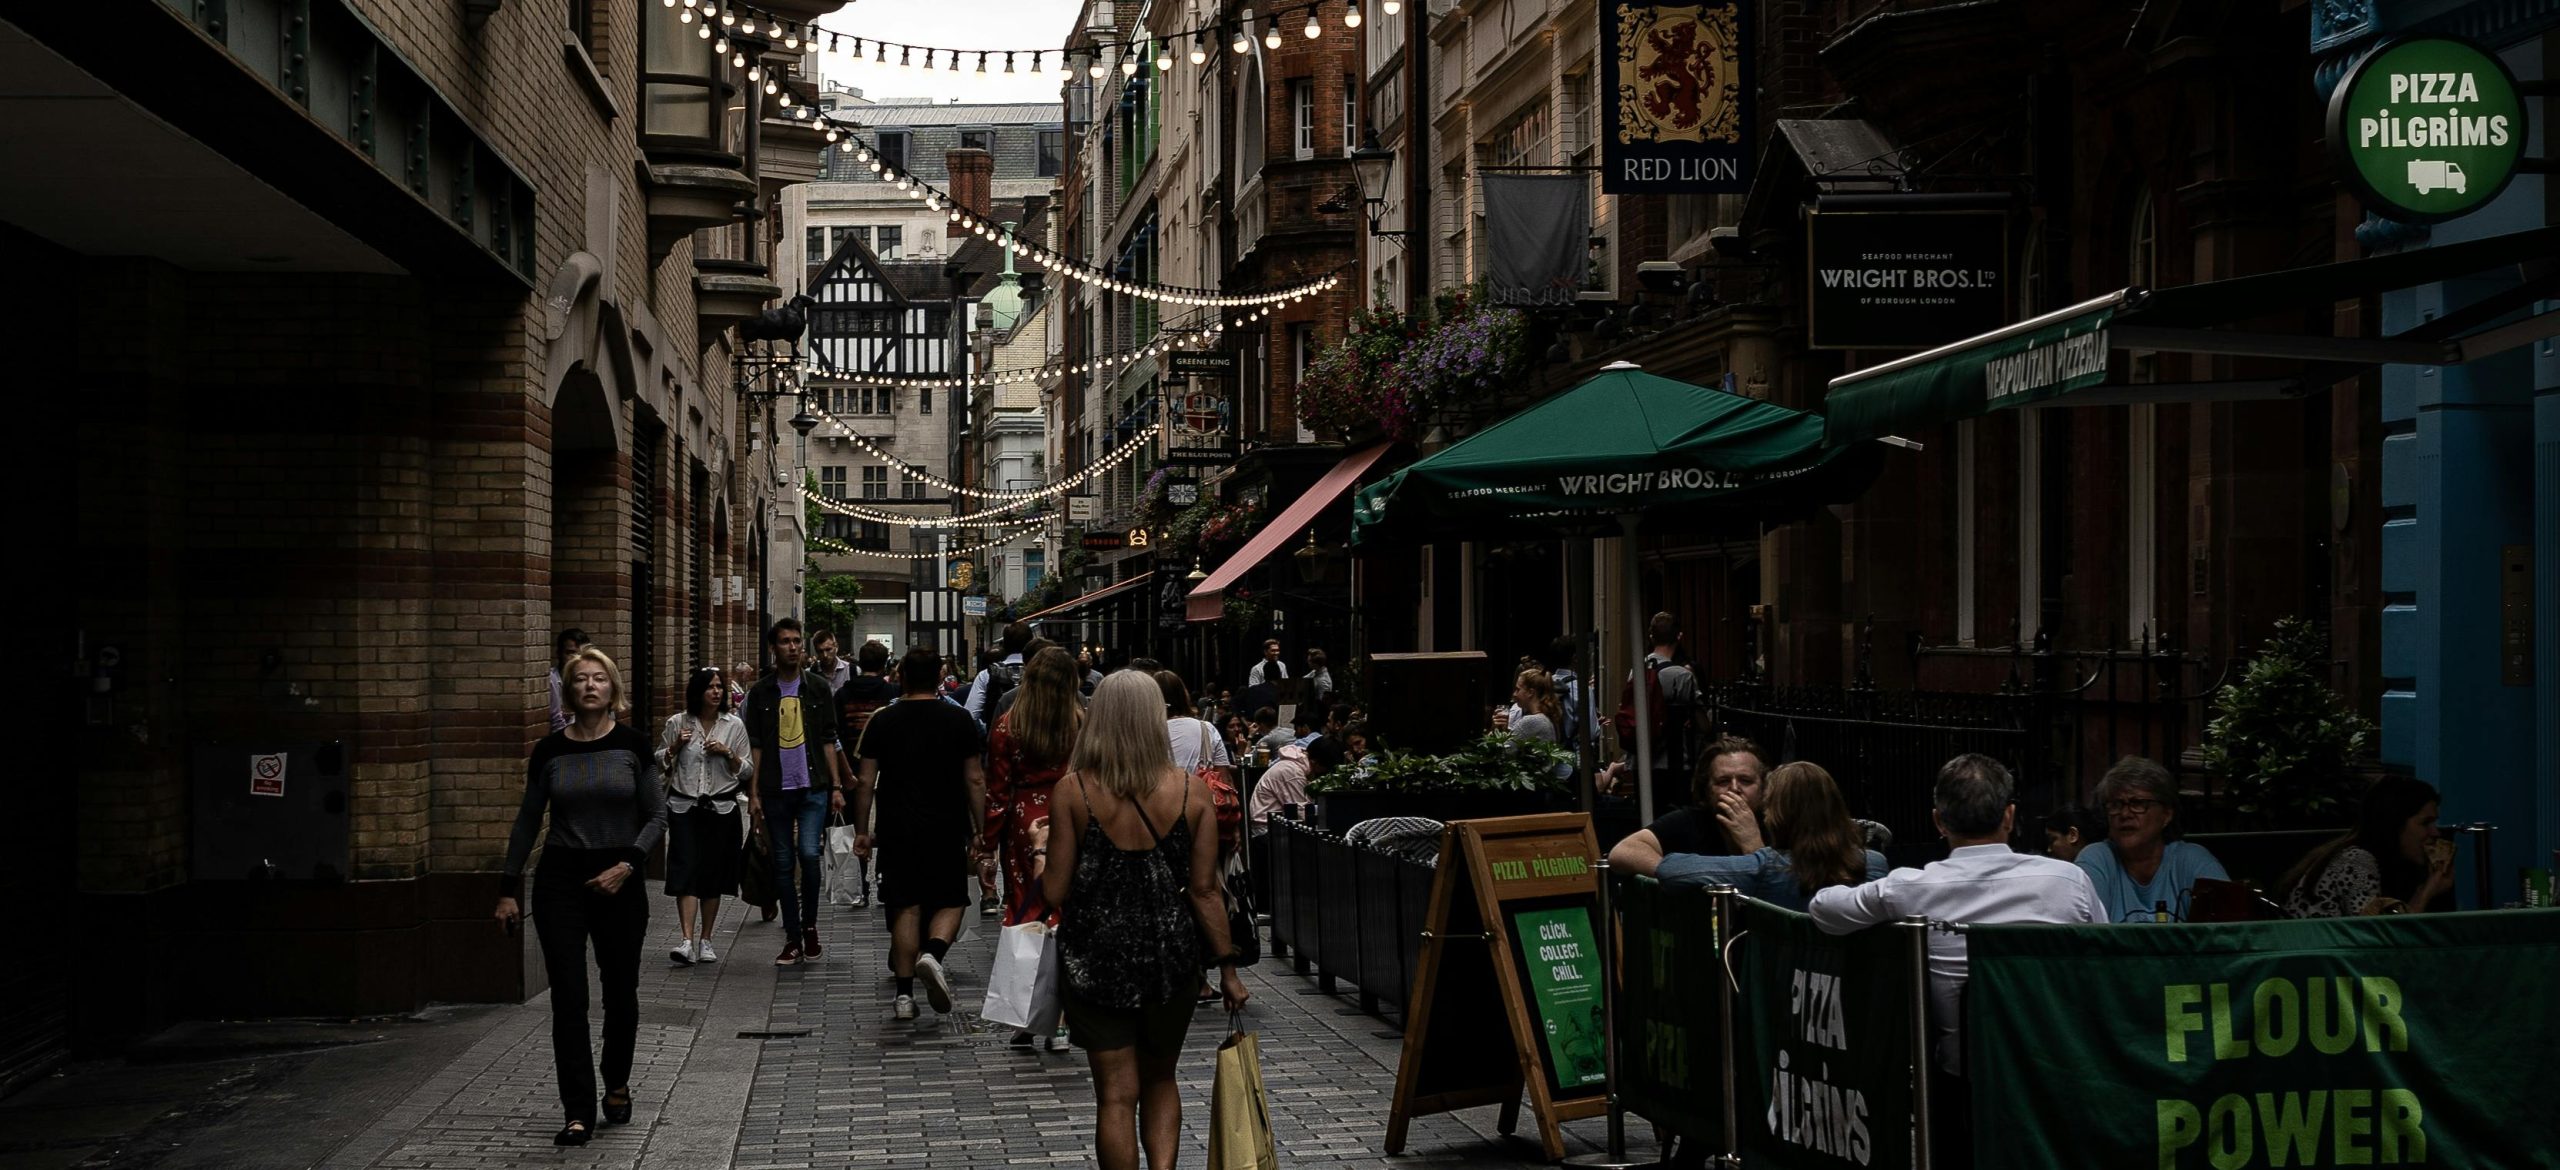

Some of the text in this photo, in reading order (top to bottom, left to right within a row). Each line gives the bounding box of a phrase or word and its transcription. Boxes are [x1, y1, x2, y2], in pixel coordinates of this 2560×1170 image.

[2390, 73, 2479, 104] PIZZA
[1624, 158, 1737, 181] RED LION
[1861, 253, 1953, 261] SEAFOOD MERCHANT
[1819, 269, 1908, 288] WRIGHT
[1860, 297, 1956, 305] OF BOROUGH LONDON
[1175, 358, 1231, 367] GREENE KING
[1447, 487, 1493, 500] SEAFOOD
[1558, 471, 1655, 496] WRIGHT
[1491, 860, 1529, 881] PIZZA
[1539, 919, 1573, 941] CLICK.
[1539, 942, 1584, 962] COLLECT.
[1551, 960, 1584, 982] CHILL.
[2163, 975, 2409, 1063] FLOUR
[2155, 1087, 2428, 1170] POWER
